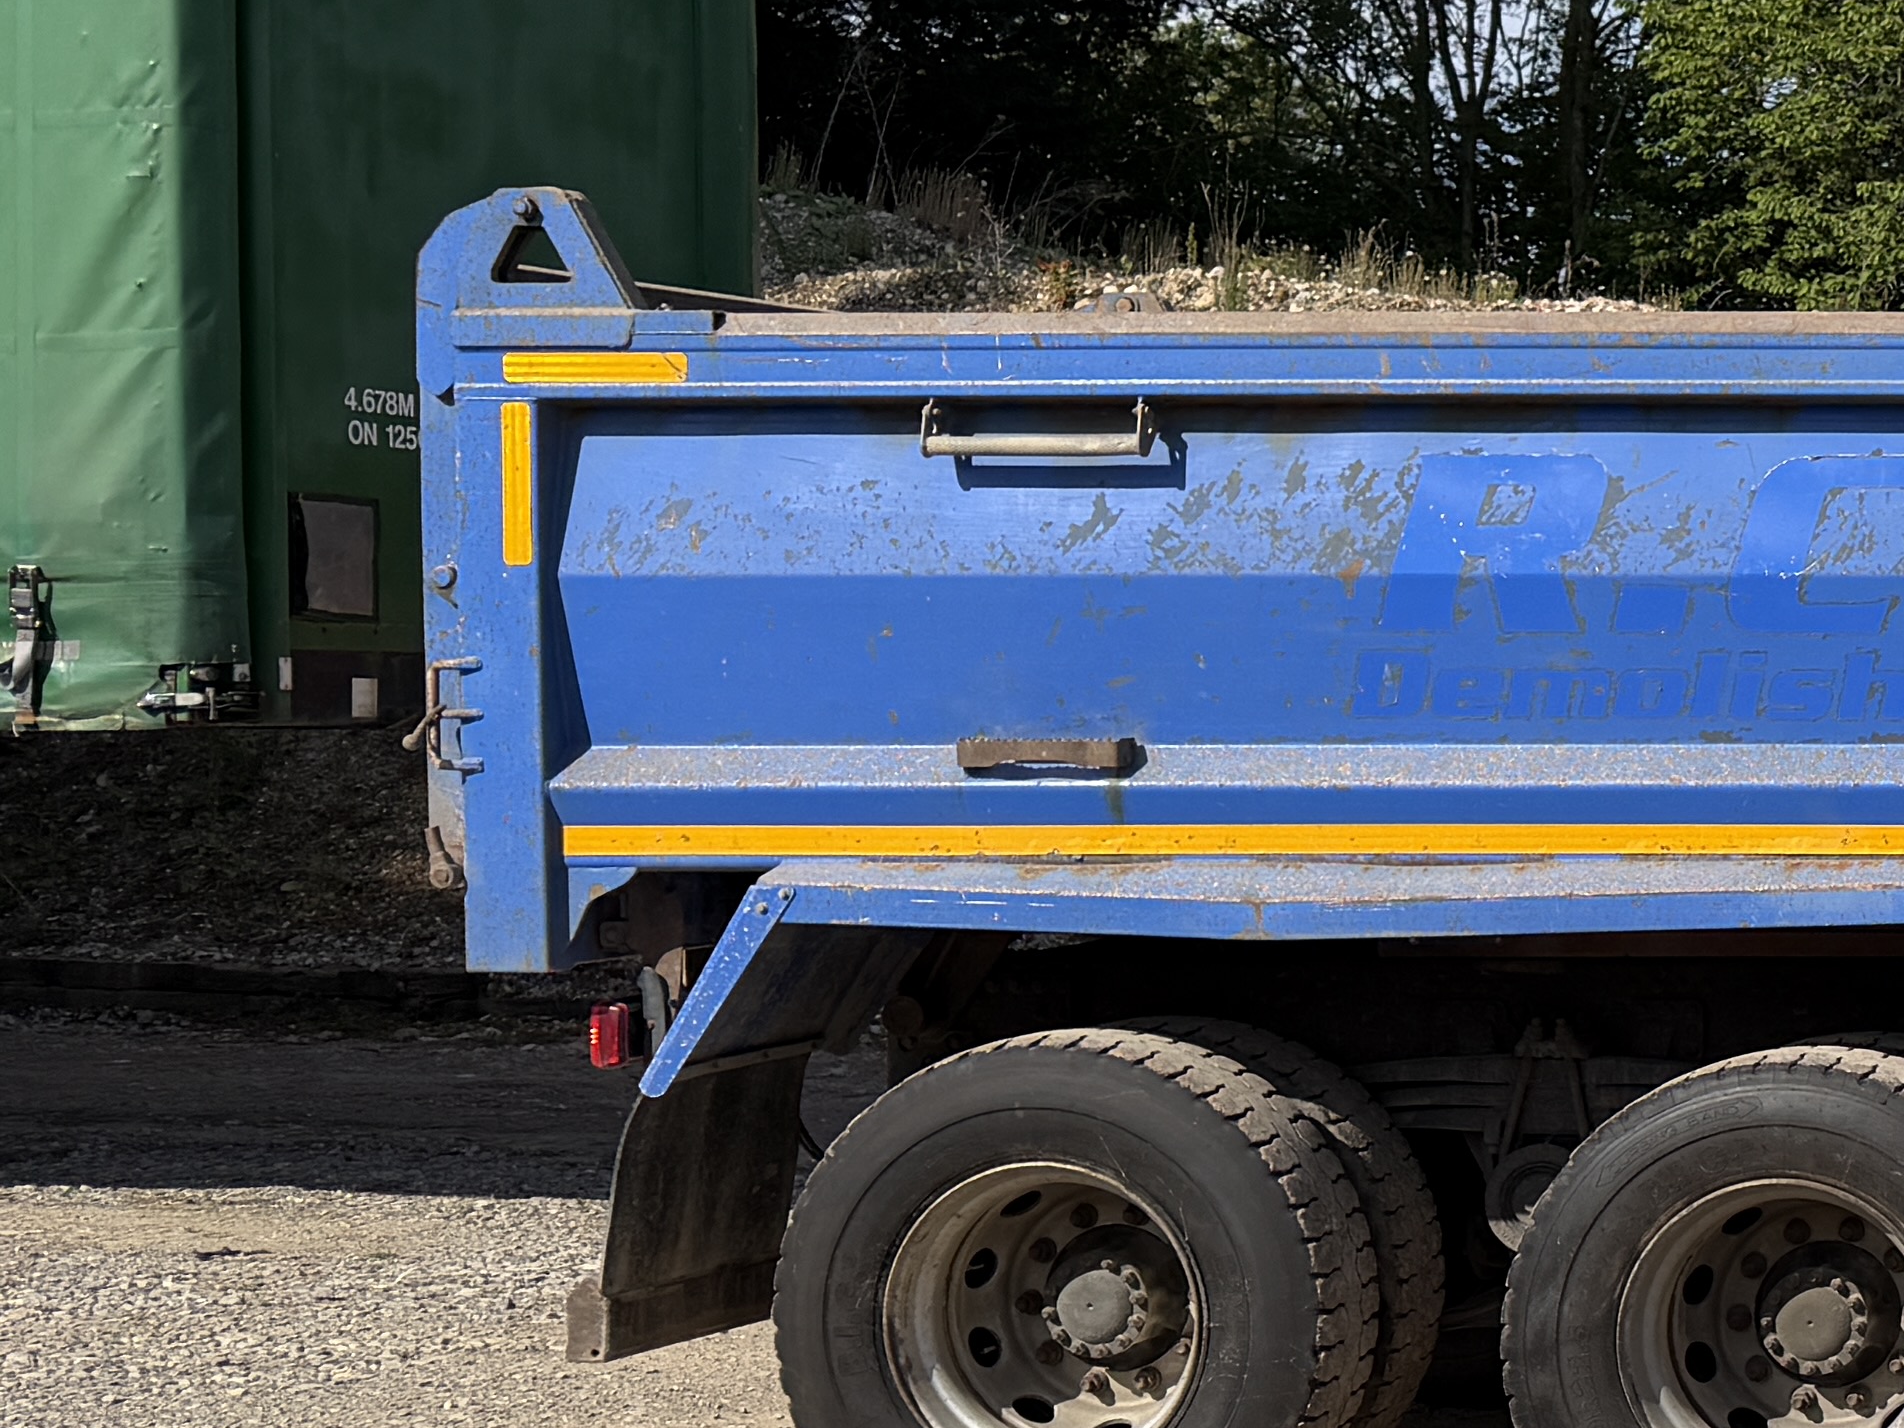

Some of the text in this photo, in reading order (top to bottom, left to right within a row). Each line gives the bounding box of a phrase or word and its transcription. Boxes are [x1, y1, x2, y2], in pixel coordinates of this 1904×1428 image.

[344, 386, 414, 418] 4.678M
[348, 419, 421, 451] ON 125
